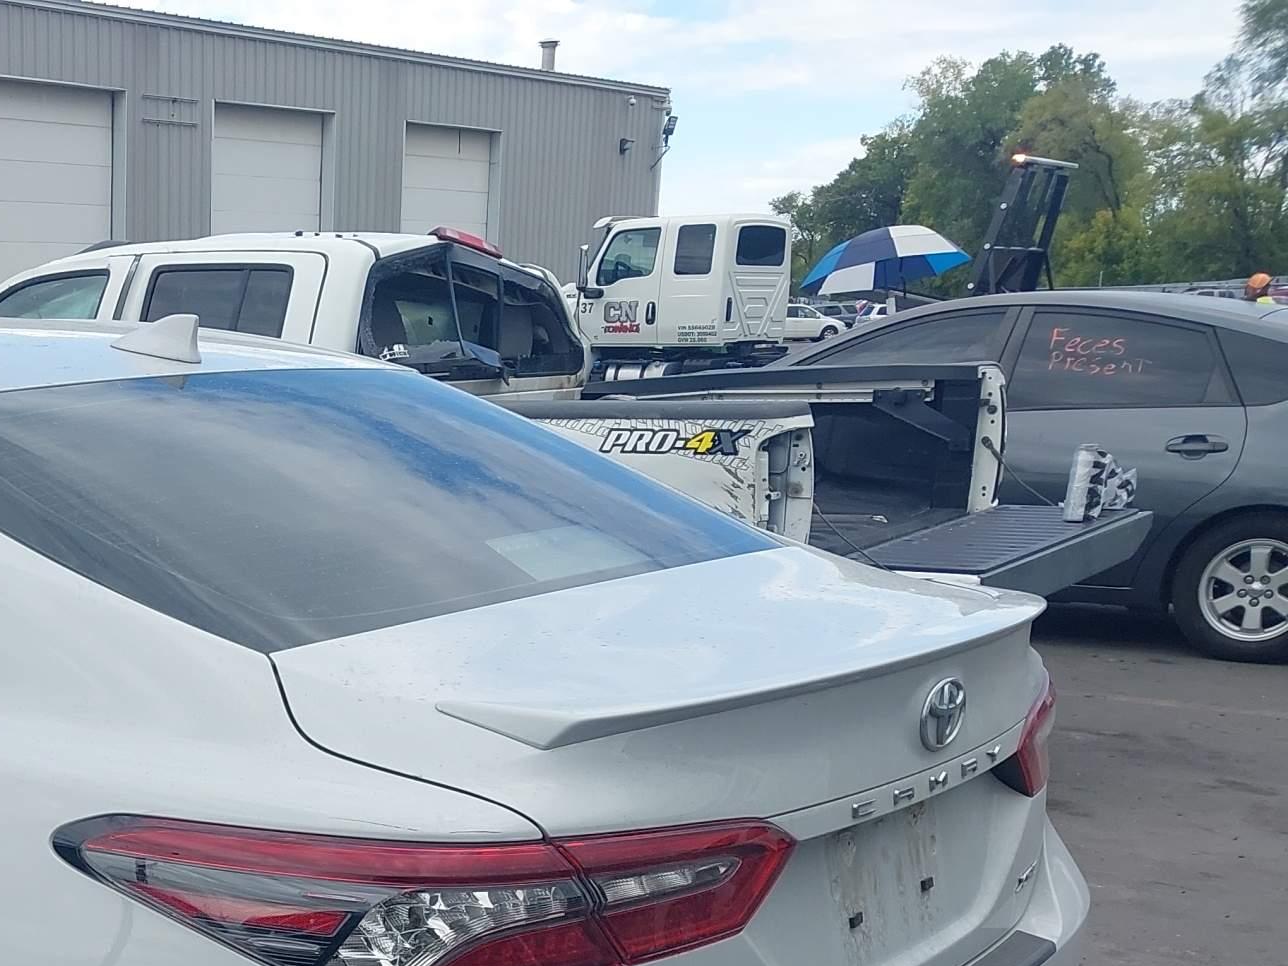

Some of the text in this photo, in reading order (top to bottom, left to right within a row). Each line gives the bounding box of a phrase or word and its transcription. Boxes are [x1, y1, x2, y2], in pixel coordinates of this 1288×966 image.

[580, 302, 594, 314] 37
[603, 301, 639, 323] CN
[1048, 327, 1127, 356] Feces
[598, 428, 754, 456] PRO-4X
[851, 743, 1002, 820] CAMRY
